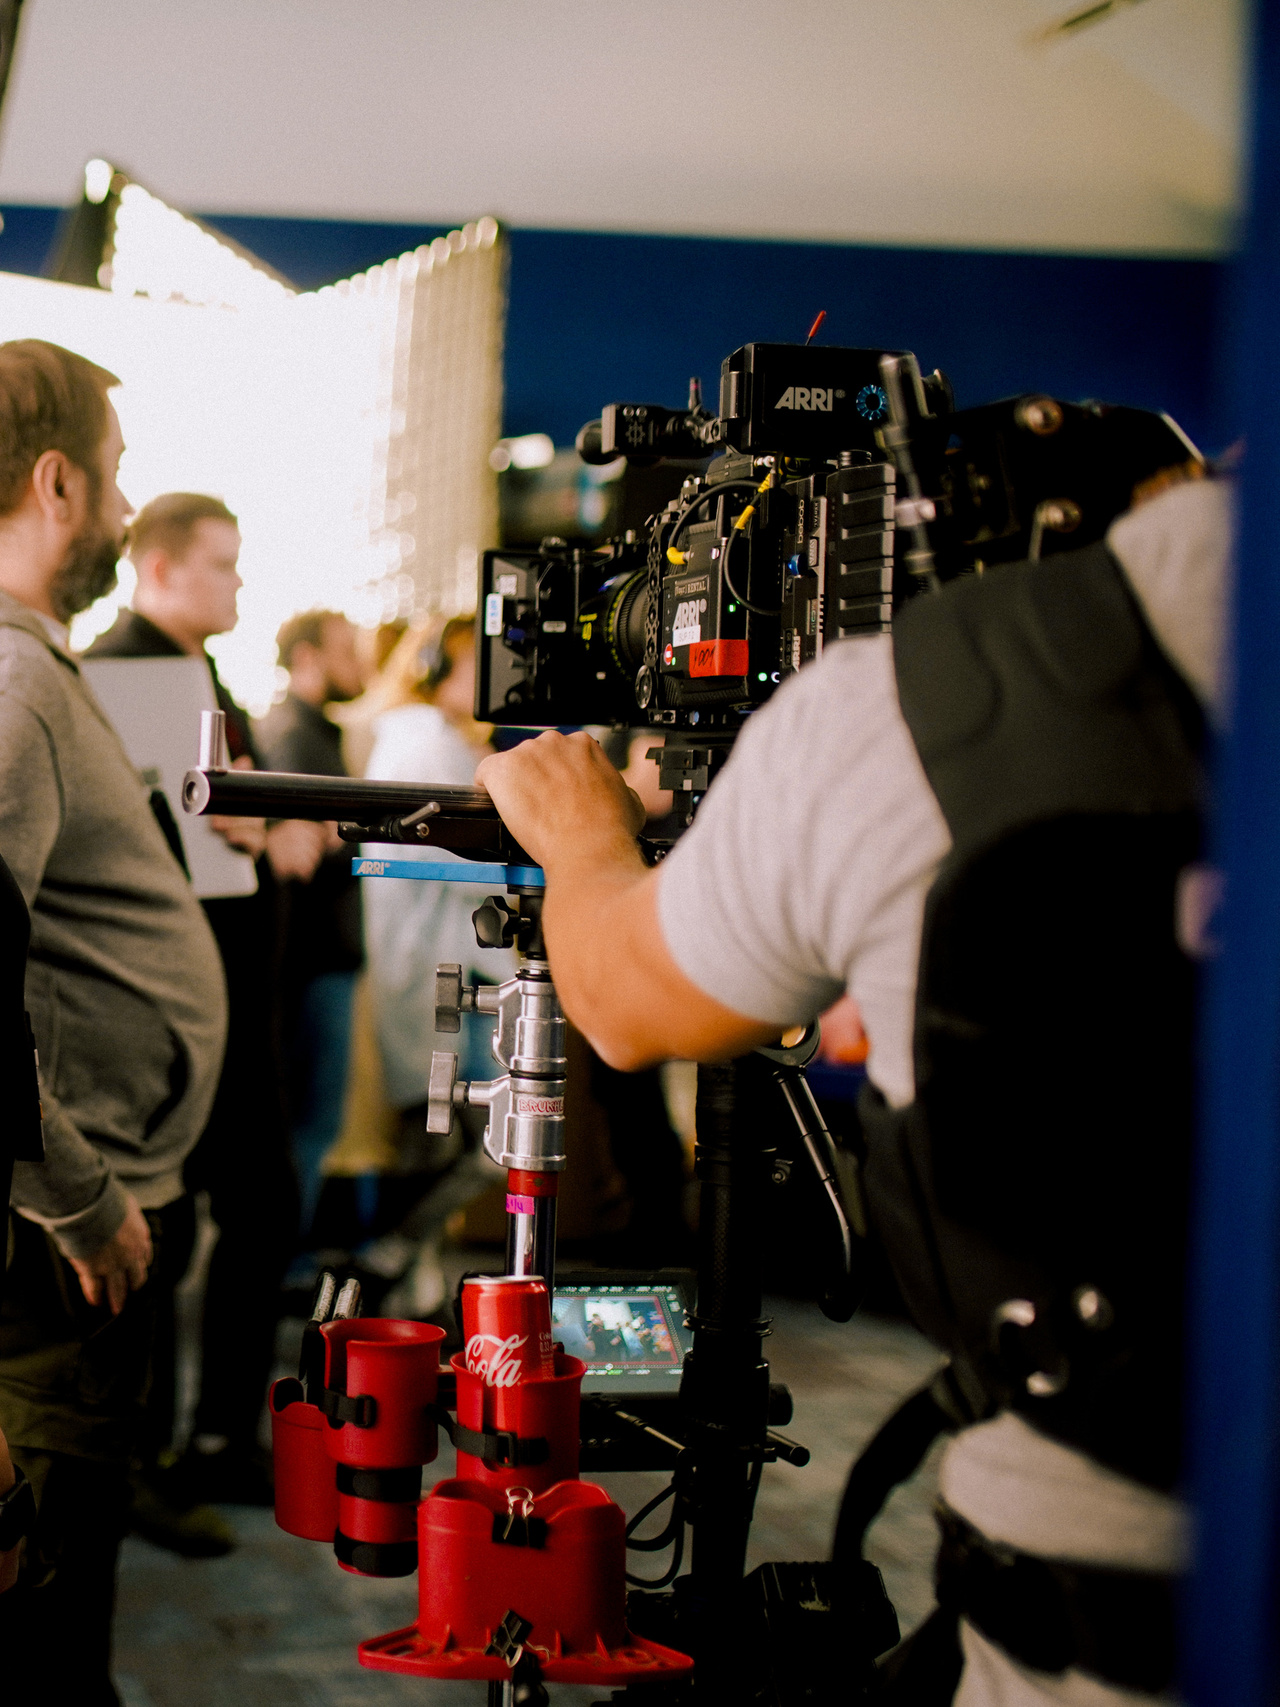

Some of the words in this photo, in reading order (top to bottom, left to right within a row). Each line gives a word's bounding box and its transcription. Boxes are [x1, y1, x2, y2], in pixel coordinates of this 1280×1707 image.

[774, 386, 834, 412] ARRI
[796, 499, 805, 544] bebob
[687, 580, 707, 595] RENTAL
[672, 599, 700, 630] ARRI
[792, 635, 801, 674] ARRI
[356, 860, 385, 876] ARRI
[465, 1334, 529, 1388] Cola
